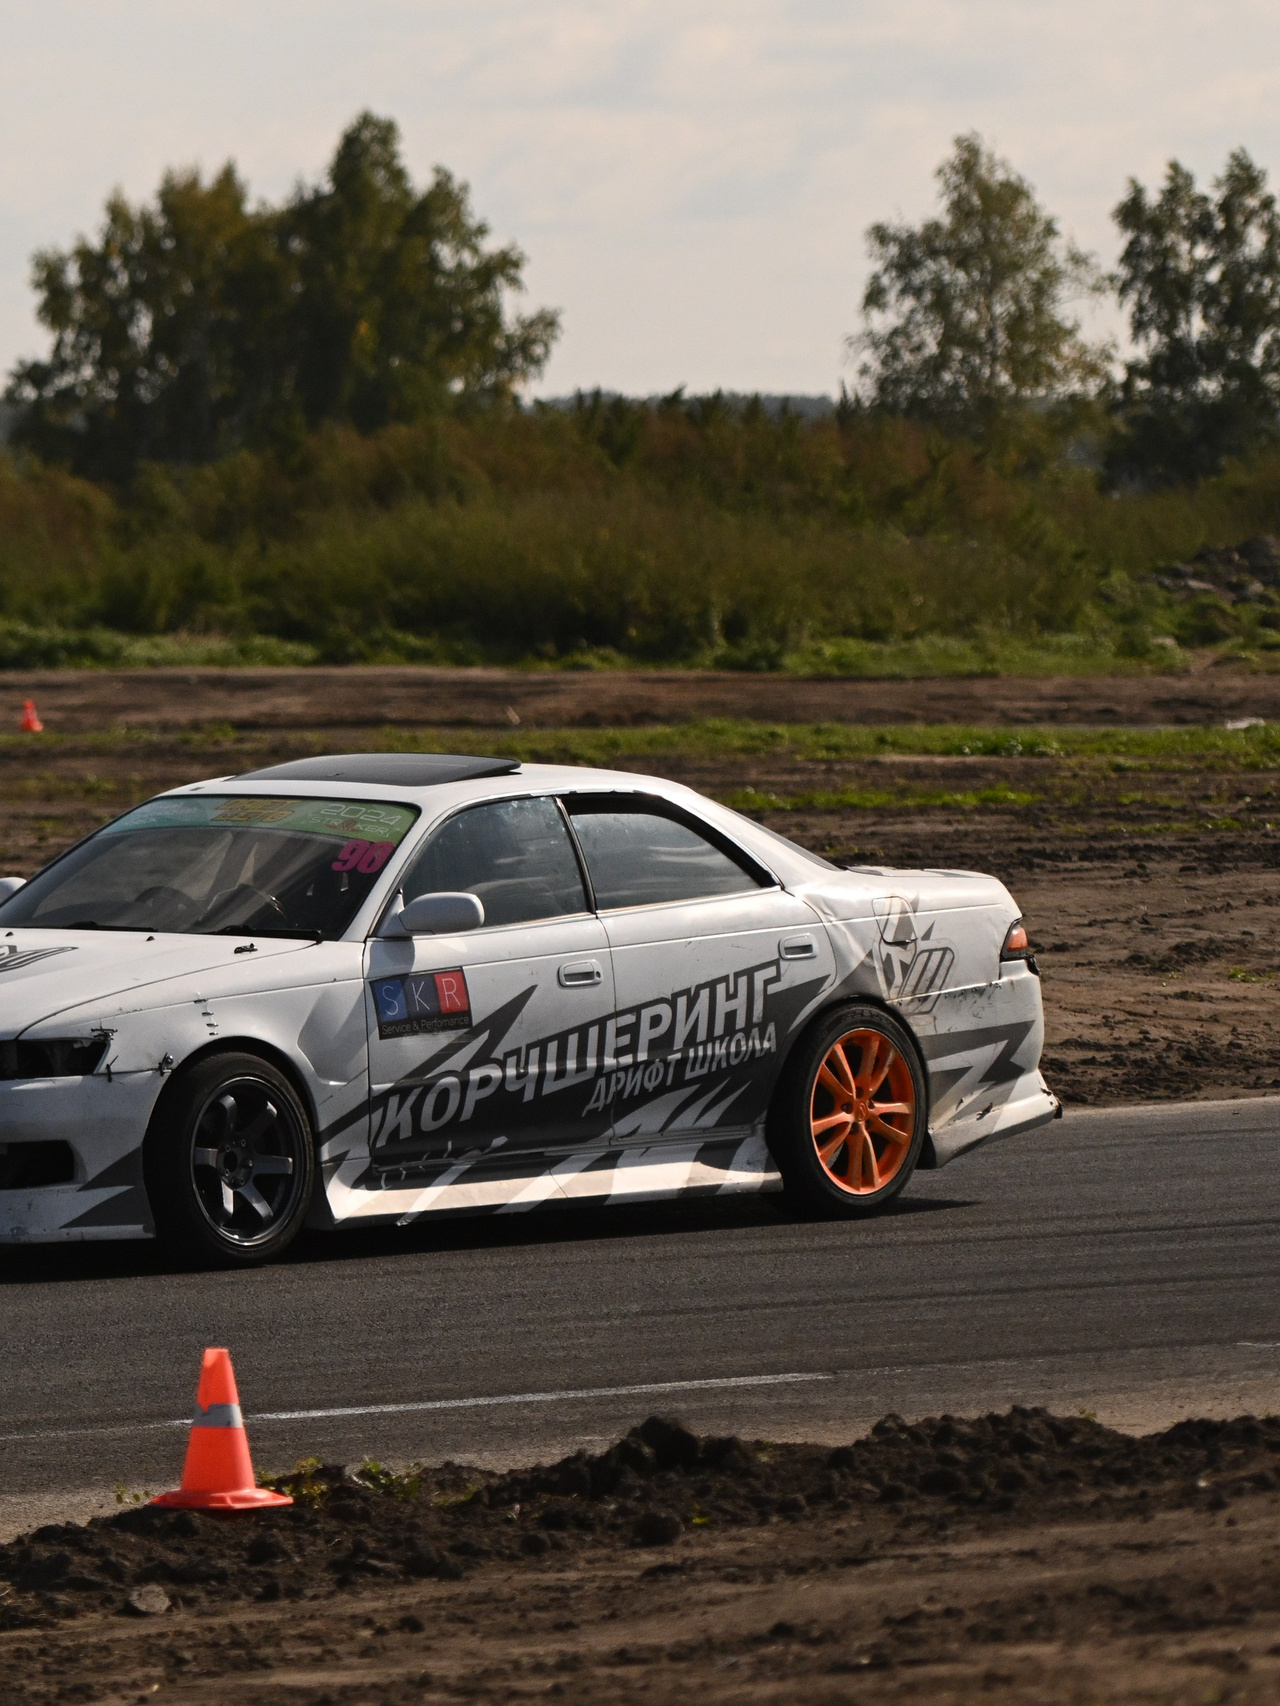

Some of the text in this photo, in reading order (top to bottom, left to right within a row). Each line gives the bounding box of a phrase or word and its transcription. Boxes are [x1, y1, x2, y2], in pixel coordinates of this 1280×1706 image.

[320, 804, 402, 825] 2024
[331, 838, 396, 874] 90
[382, 978, 461, 1015] SKR
[382, 1023, 411, 1035] Service
[413, 1021, 420, 1032] &
[376, 964, 779, 1148] КОРЧШЕРИНГ
[582, 1022, 777, 1118] ДРИФТ ШКОЛА
